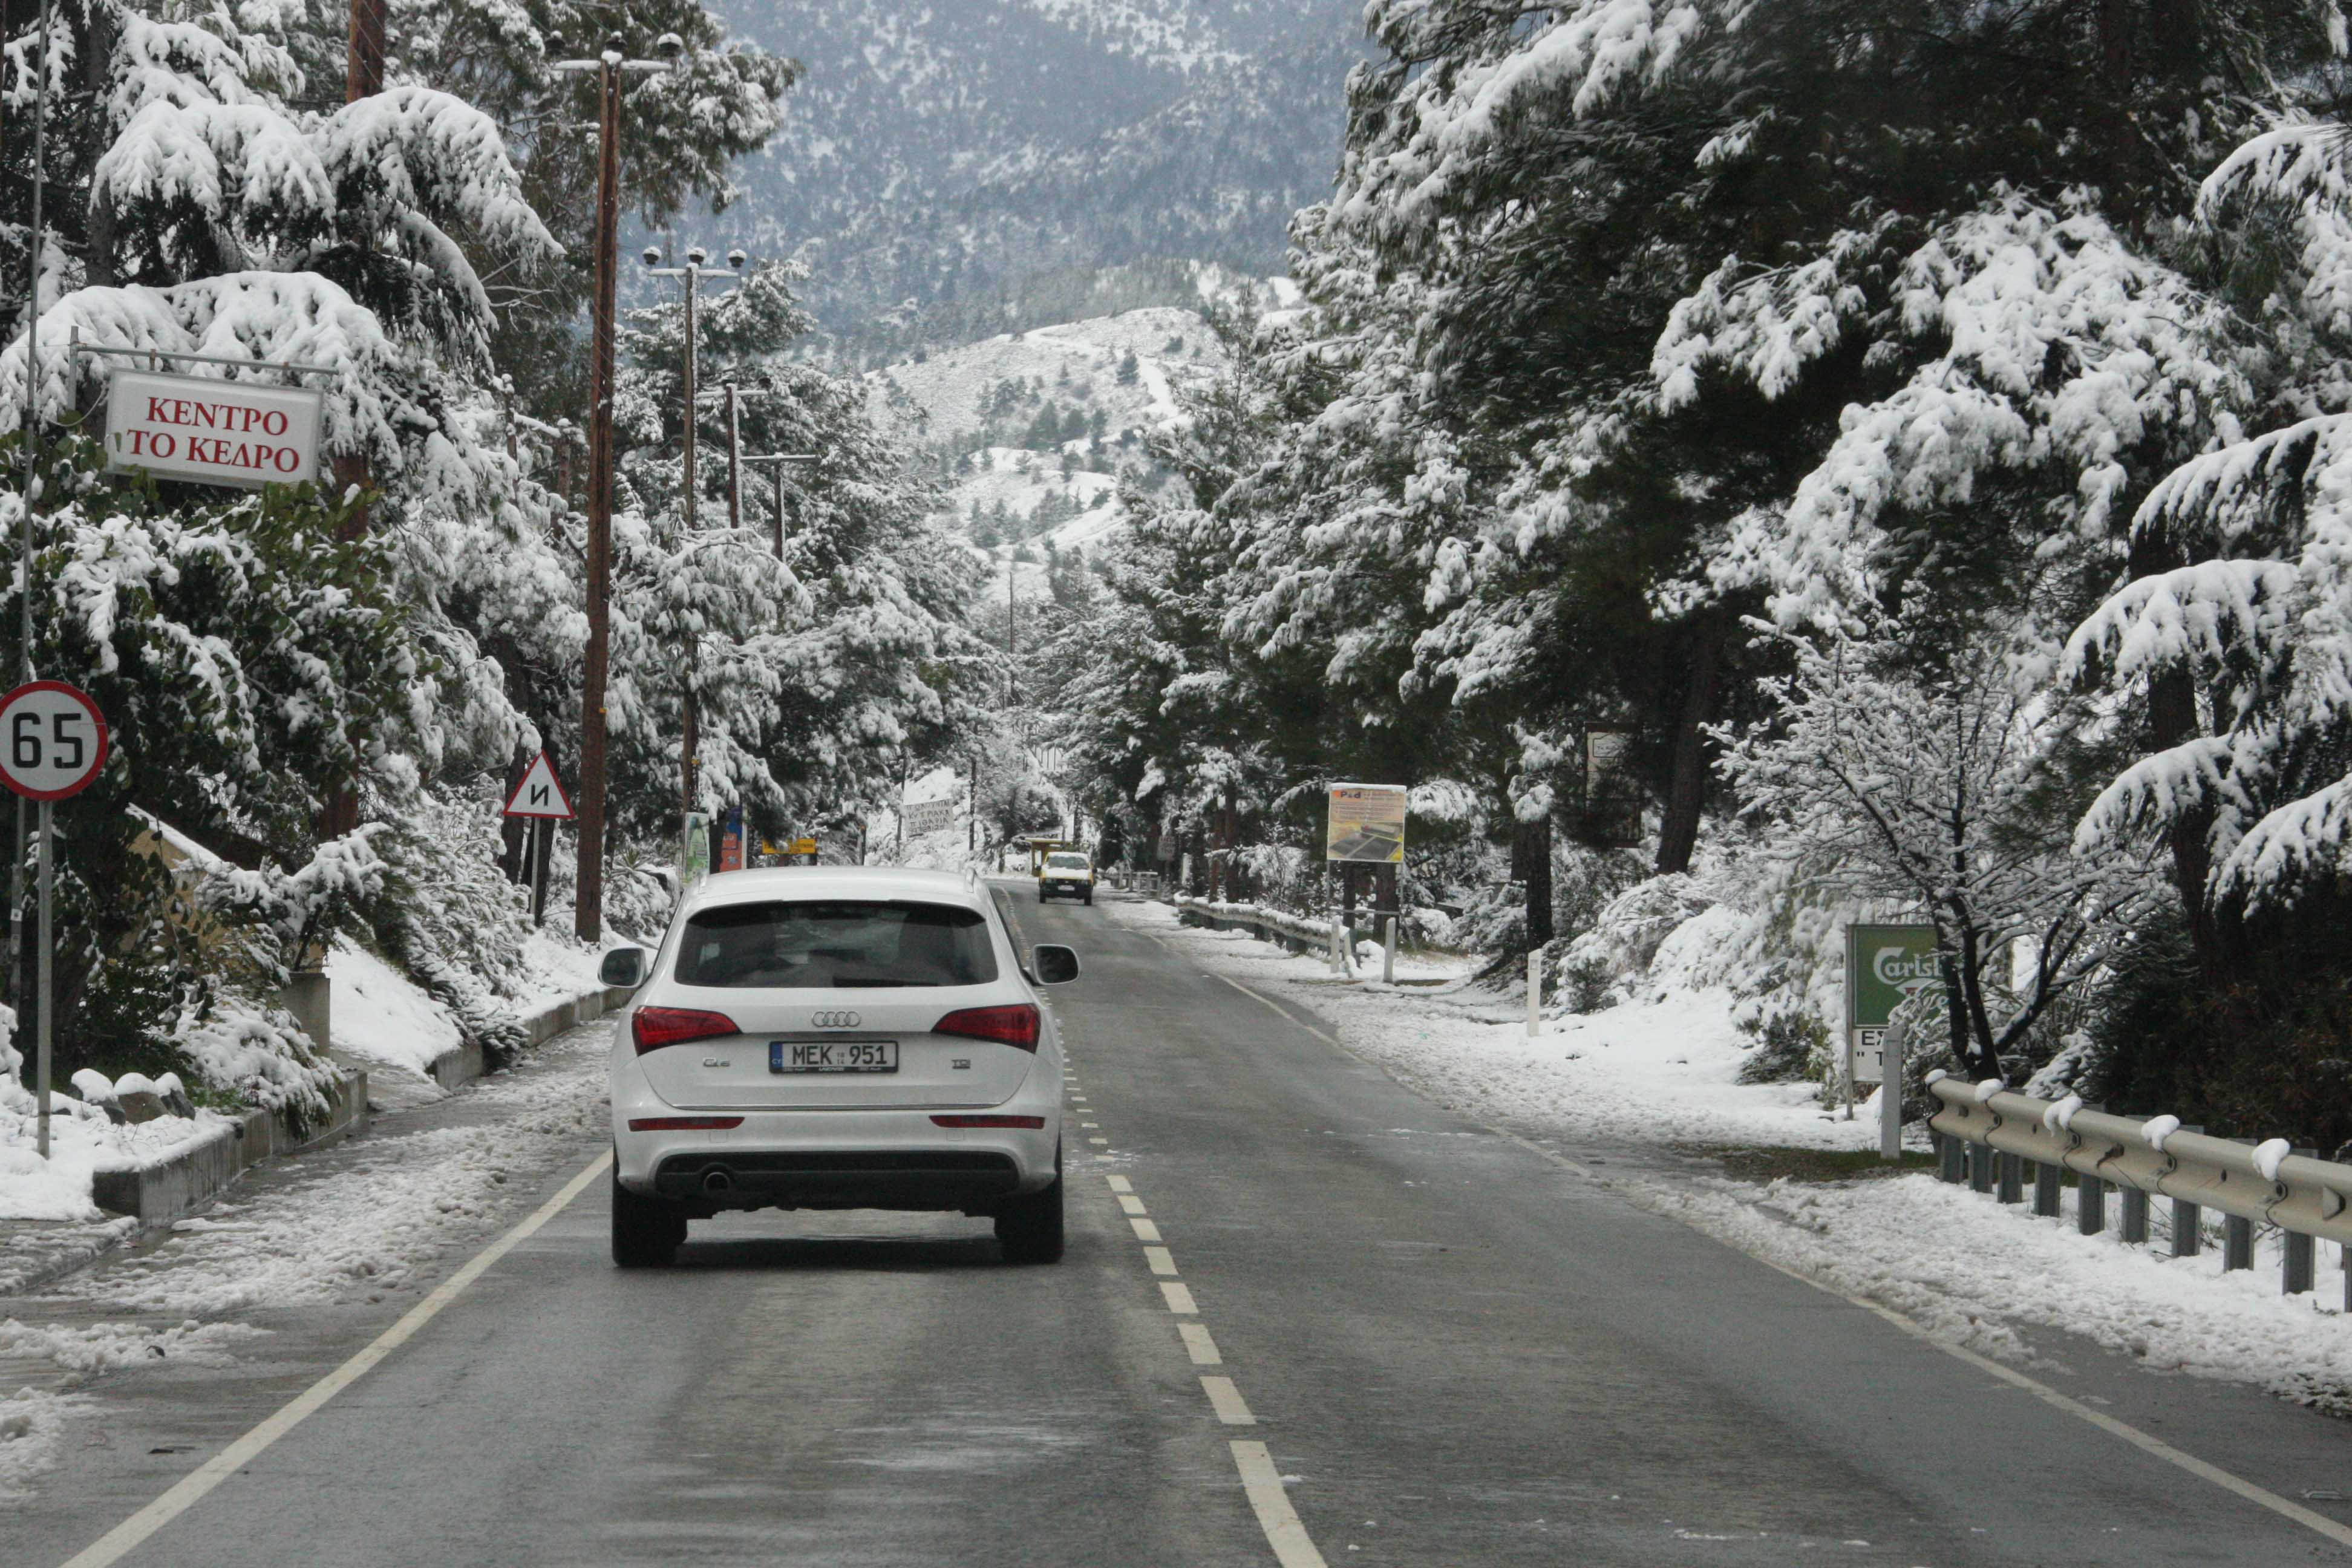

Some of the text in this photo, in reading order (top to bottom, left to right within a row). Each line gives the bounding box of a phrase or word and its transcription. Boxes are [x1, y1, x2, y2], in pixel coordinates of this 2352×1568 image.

[146, 396, 289, 436] ΚΕΝΤΡΟ
[126, 428, 300, 473] ΤΟ ΚΕΔΡΟ
[12, 711, 83, 769] 65
[792, 1045, 832, 1065] MEK
[849, 1045, 887, 1065] 951
